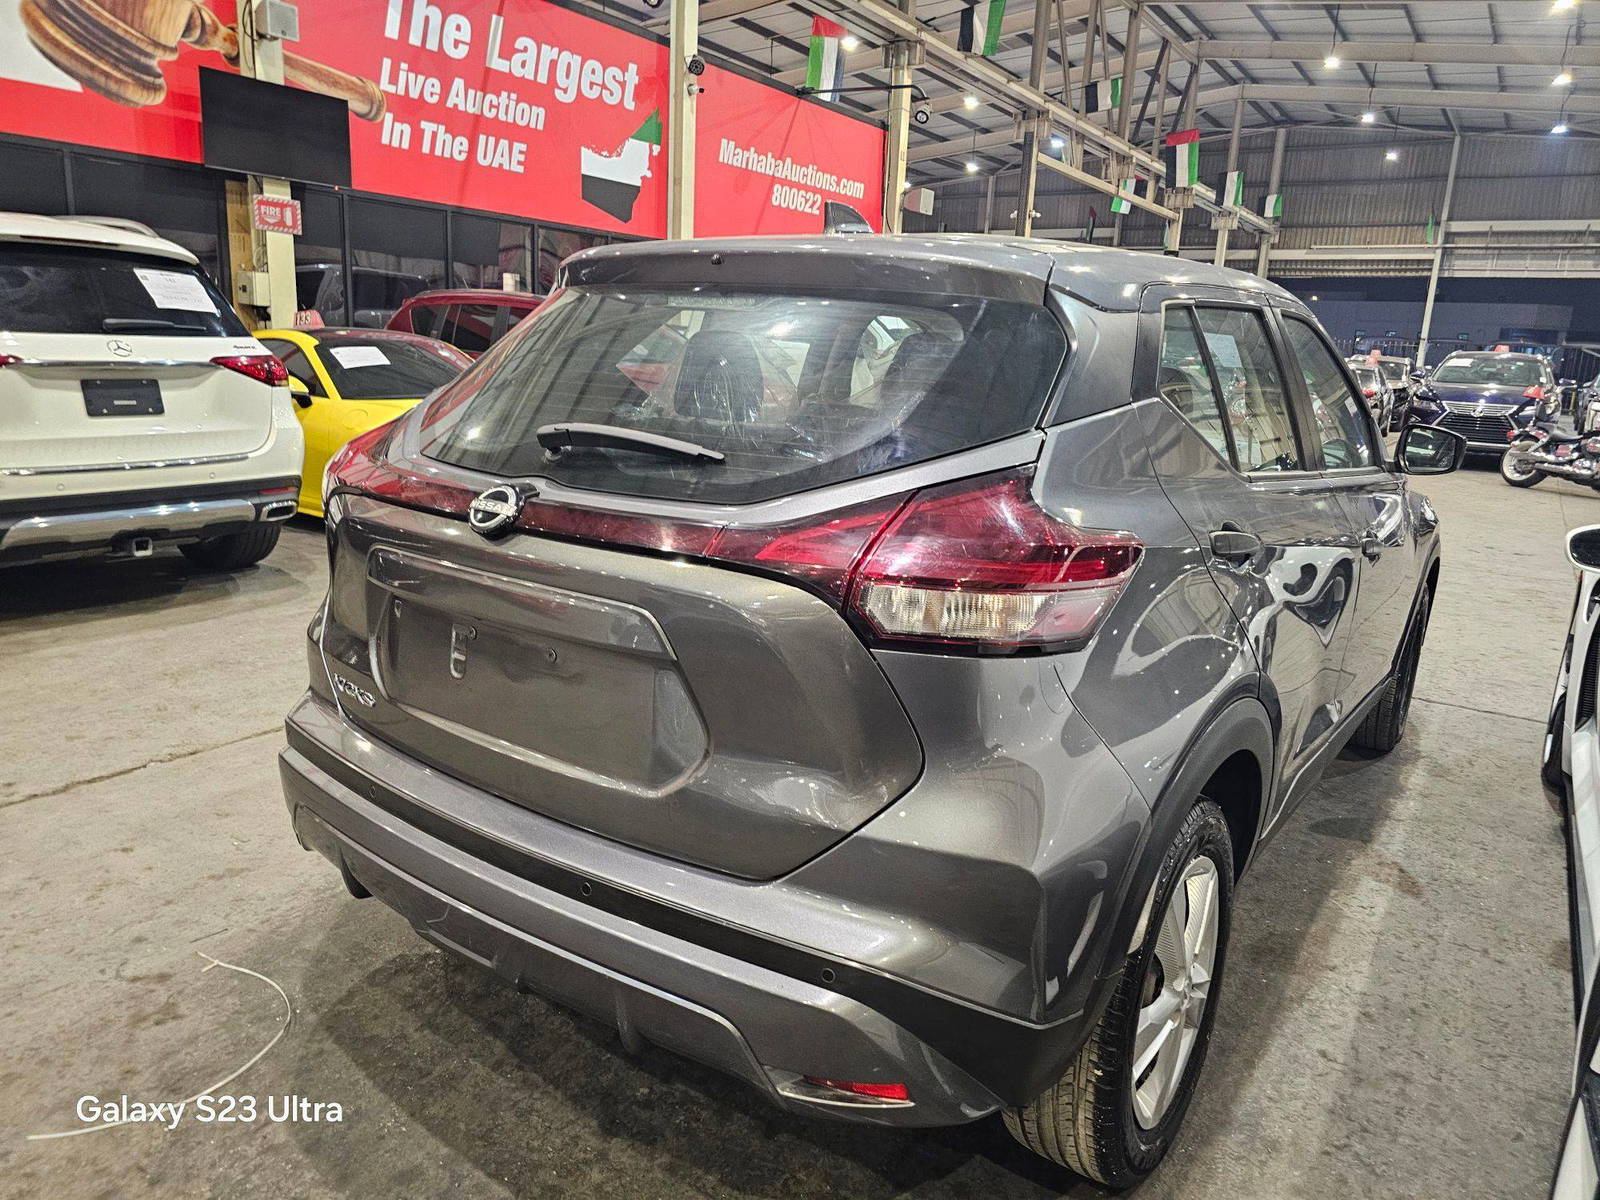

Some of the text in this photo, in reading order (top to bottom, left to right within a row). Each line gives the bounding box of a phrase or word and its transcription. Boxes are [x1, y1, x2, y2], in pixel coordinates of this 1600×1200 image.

[485, 14, 639, 111] Largest
[379, 57, 546, 131] Live Auction
[380, 112, 528, 174] In The UAE
[718, 138, 865, 200] MarhabaAuctions.com
[260, 205, 281, 217] FIRE
[771, 183, 822, 215] 800622
